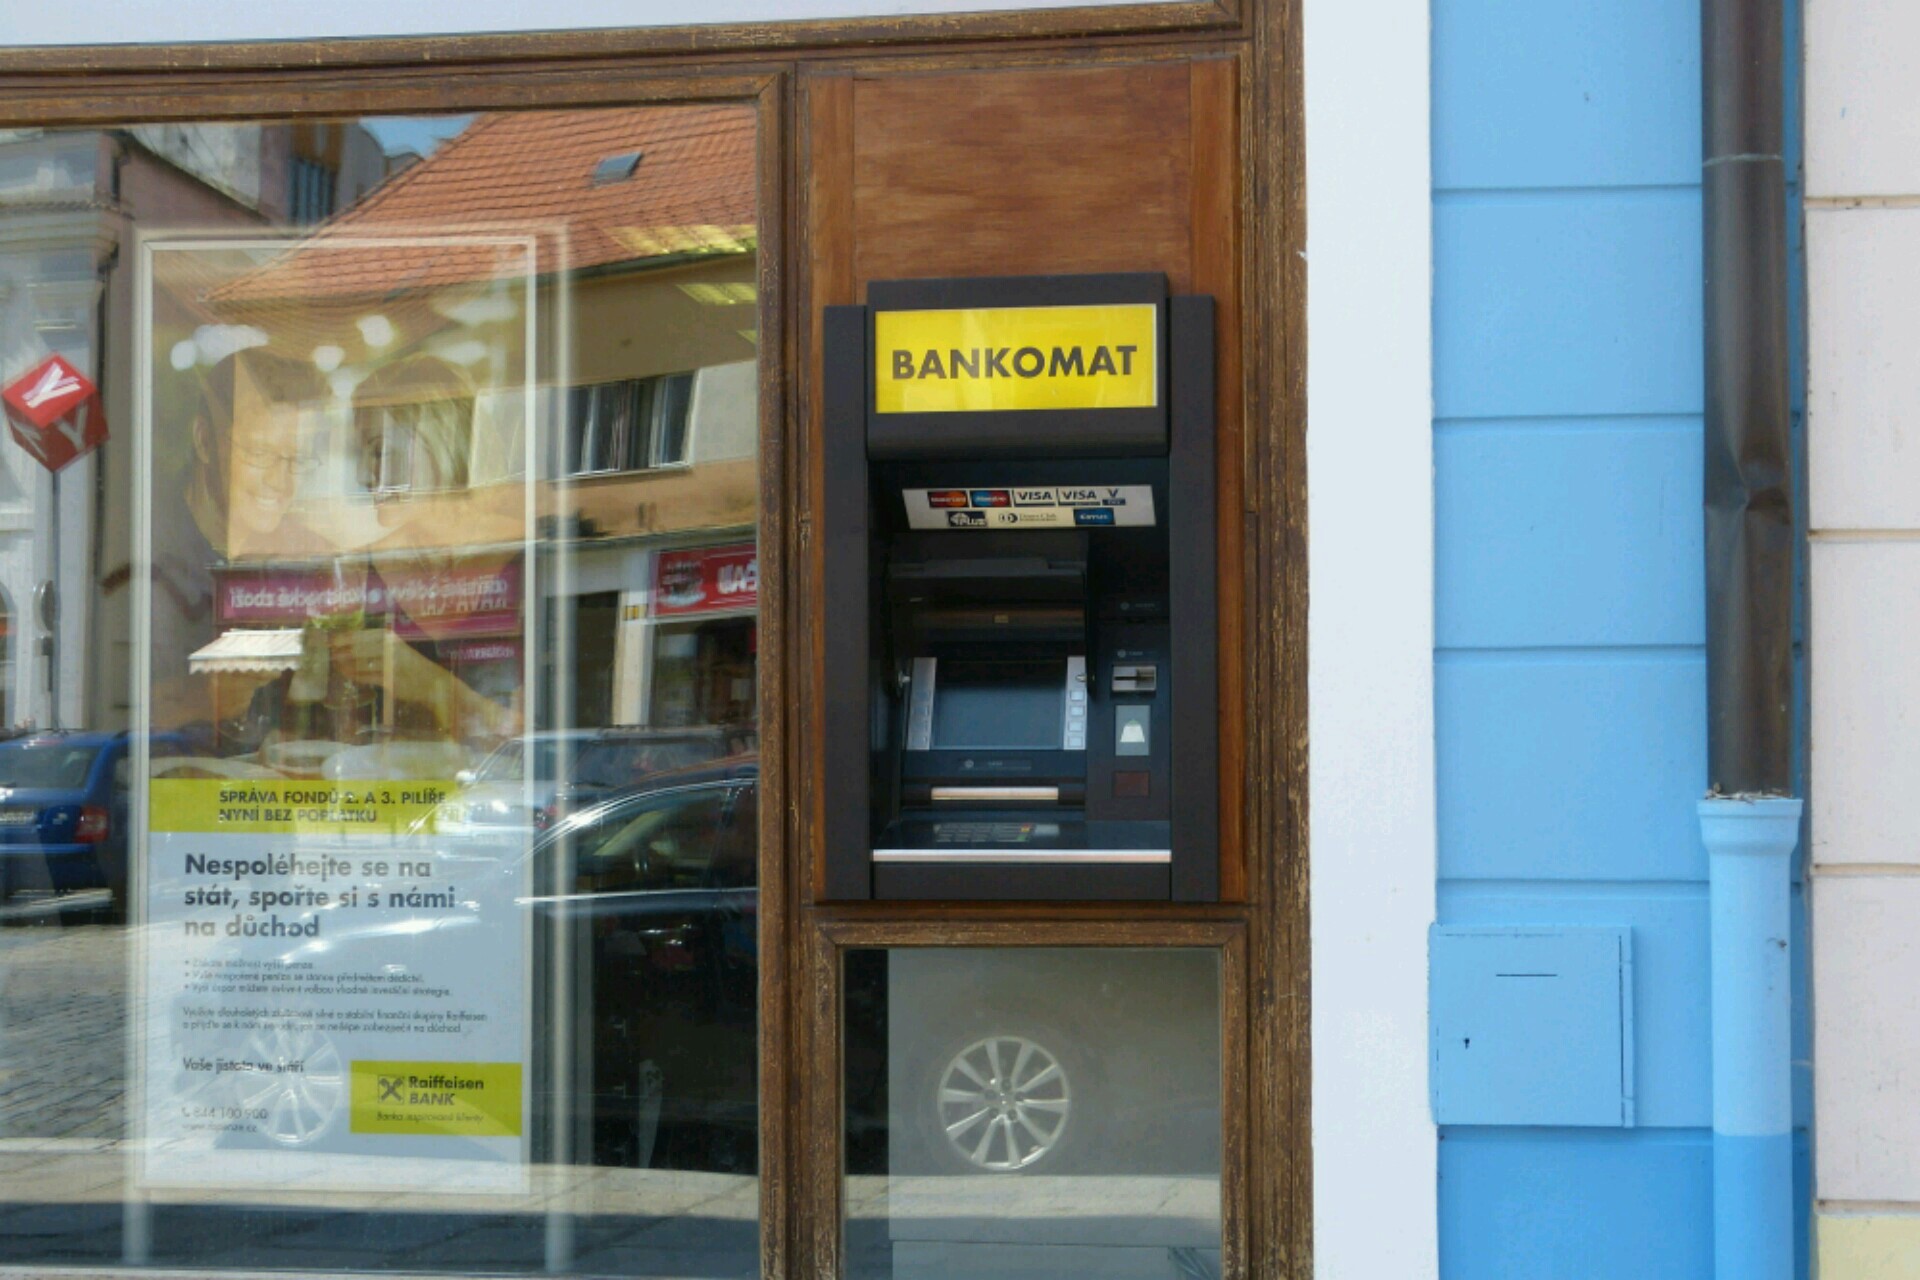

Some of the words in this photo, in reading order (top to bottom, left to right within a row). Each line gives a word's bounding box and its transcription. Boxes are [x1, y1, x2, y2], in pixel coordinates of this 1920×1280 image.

[892, 344, 1138, 380] BANKOMAT
[1018, 490, 1053, 502] VISA
[1061, 489, 1097, 501] VISA
[219, 788, 278, 805] SPRÁVA
[284, 788, 338, 805] FONDŮ
[364, 791, 376, 805] A
[380, 791, 396, 805] 3.
[219, 807, 259, 822] NYNÍ
[264, 809, 292, 822] BEZ
[298, 809, 377, 823] POPLATKU
[184, 853, 351, 882] Nespoléhejte
[361, 860, 390, 877] se
[399, 860, 431, 877] na
[184, 886, 240, 910] stát,
[248, 886, 330, 913] spořte
[340, 886, 358, 908] si
[367, 892, 380, 908] s
[388, 886, 456, 909] námi
[184, 918, 216, 937] na
[225, 914, 320, 938] důchod
[183, 1057, 213, 1072] Vaše
[408, 1075, 485, 1091] Raiffeisen
[409, 1092, 456, 1106] BANK
